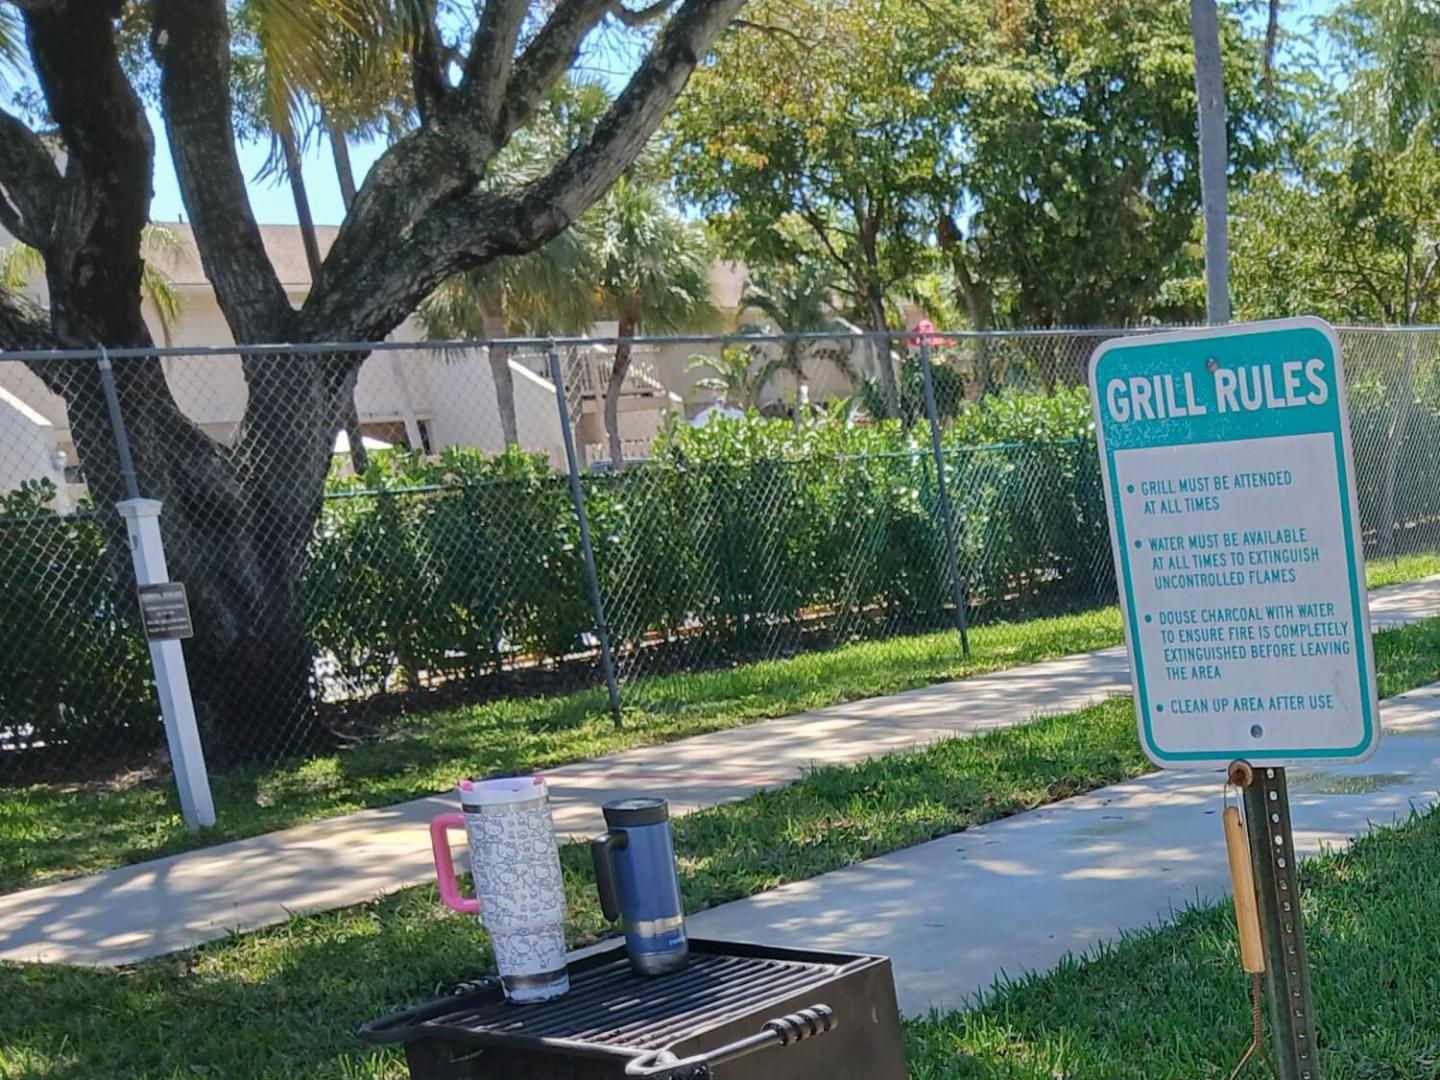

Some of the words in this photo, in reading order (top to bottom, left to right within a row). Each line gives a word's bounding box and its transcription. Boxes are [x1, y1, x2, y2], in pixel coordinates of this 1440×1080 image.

[1107, 372, 1207, 422] GRILL
[1214, 358, 1328, 413] RULES
[1141, 480, 1175, 497] GRILL
[1179, 476, 1209, 493] MUST
[1214, 475, 1229, 490] BE
[1234, 471, 1292, 489] ATTENDED
[1144, 501, 1156, 515] AT
[1161, 499, 1182, 514] ALL
[1185, 497, 1219, 512] TIMES
[1149, 537, 1184, 551] WATER
[1189, 534, 1219, 549] MUST
[1224, 532, 1239, 546] BE
[1243, 528, 1307, 545] AVAILABLE
[1152, 557, 1164, 570] AT
[1168, 556, 1190, 569] ALL
[1193, 553, 1227, 567] TIMES
[1230, 552, 1244, 565] TO
[1250, 547, 1319, 565] EXTINGUISH
[1154, 571, 1244, 590] UNCONTROLLED
[1250, 568, 1296, 584] FLAMES
[1159, 610, 1197, 625] DOUSE
[1201, 607, 1262, 623] CHARCOAL
[1265, 605, 1294, 619] WITH
[1298, 603, 1334, 617] WATER
[1161, 630, 1175, 644] TO
[1179, 627, 1224, 643] ENSURE
[1229, 626, 1254, 640] FIRE
[1259, 625, 1270, 639] IS
[1274, 621, 1348, 638] COMPLETELY
[1164, 645, 1246, 662] EXTINGUISHED
[1250, 643, 1296, 658] BEFORE
[1301, 640, 1350, 656] LEAVING
[1166, 668, 1186, 680] THE
[1191, 666, 1221, 679] AREA
[1171, 699, 1208, 714] CLEAN
[1213, 698, 1229, 712] UP
[1233, 698, 1264, 711] AREA
[1269, 696, 1305, 710] AFTER
[1309, 695, 1334, 709] USE
